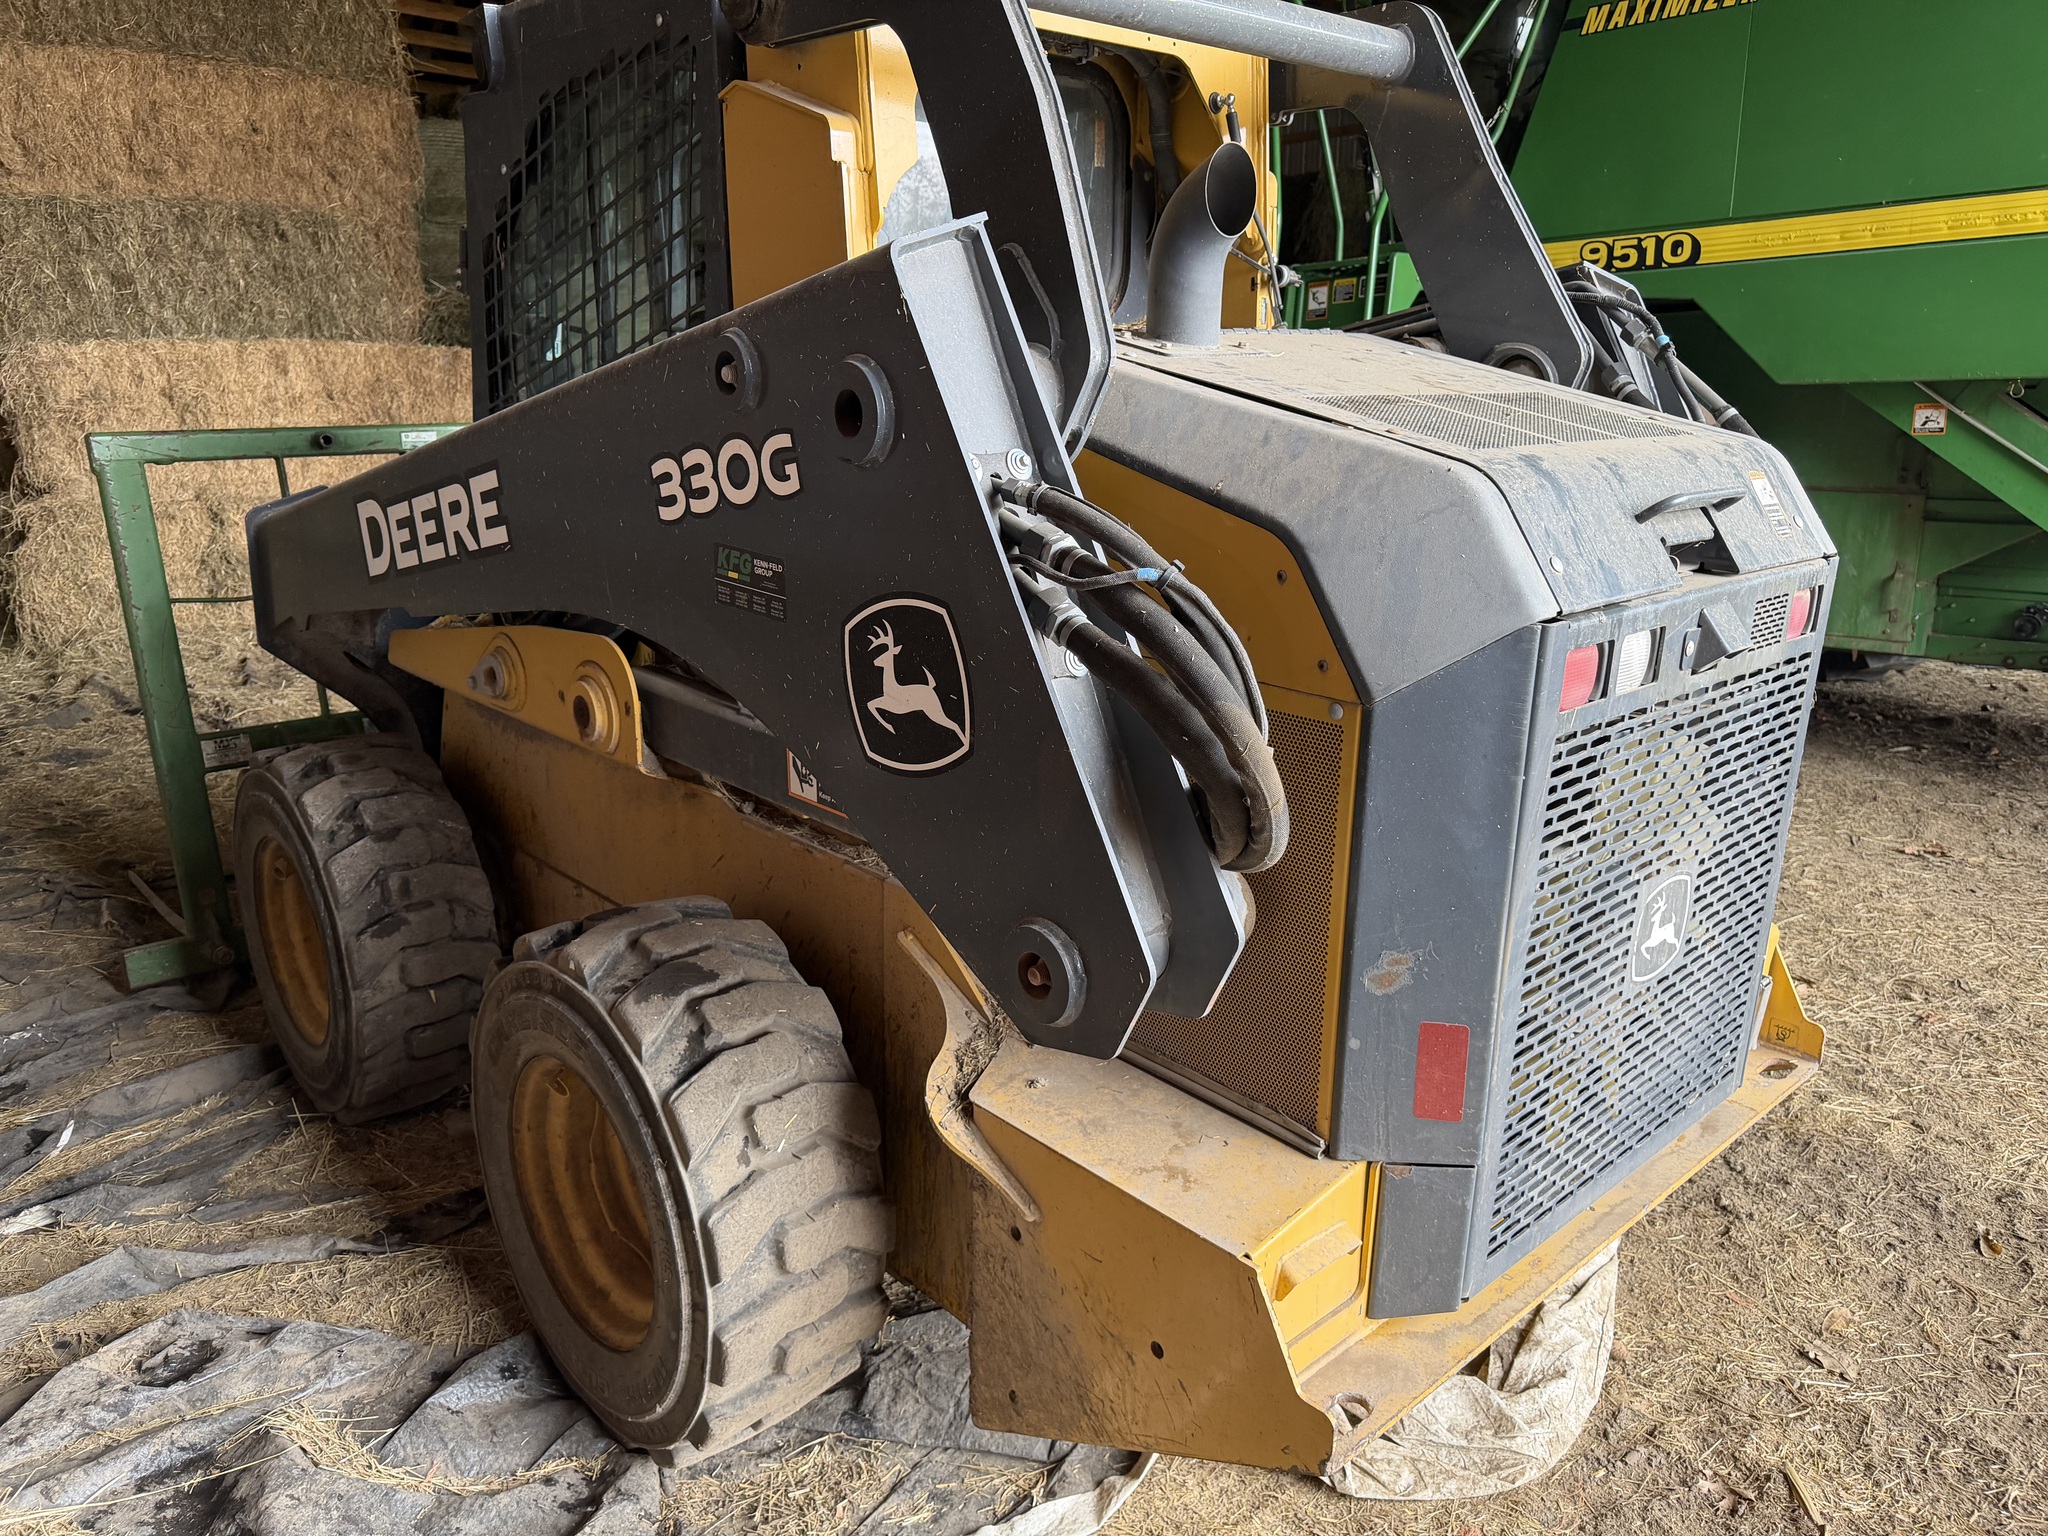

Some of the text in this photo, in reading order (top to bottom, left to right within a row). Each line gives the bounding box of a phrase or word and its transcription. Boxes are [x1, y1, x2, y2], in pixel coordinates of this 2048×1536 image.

[1580, 0, 1757, 35] MAXIM
[1581, 232, 1700, 271] 9510
[651, 433, 801, 521] 330G
[357, 469, 509, 577] DEERE
[717, 546, 752, 575] KFG
[753, 558, 783, 573] KENN-FELD
[754, 566, 774, 578] GROUP
